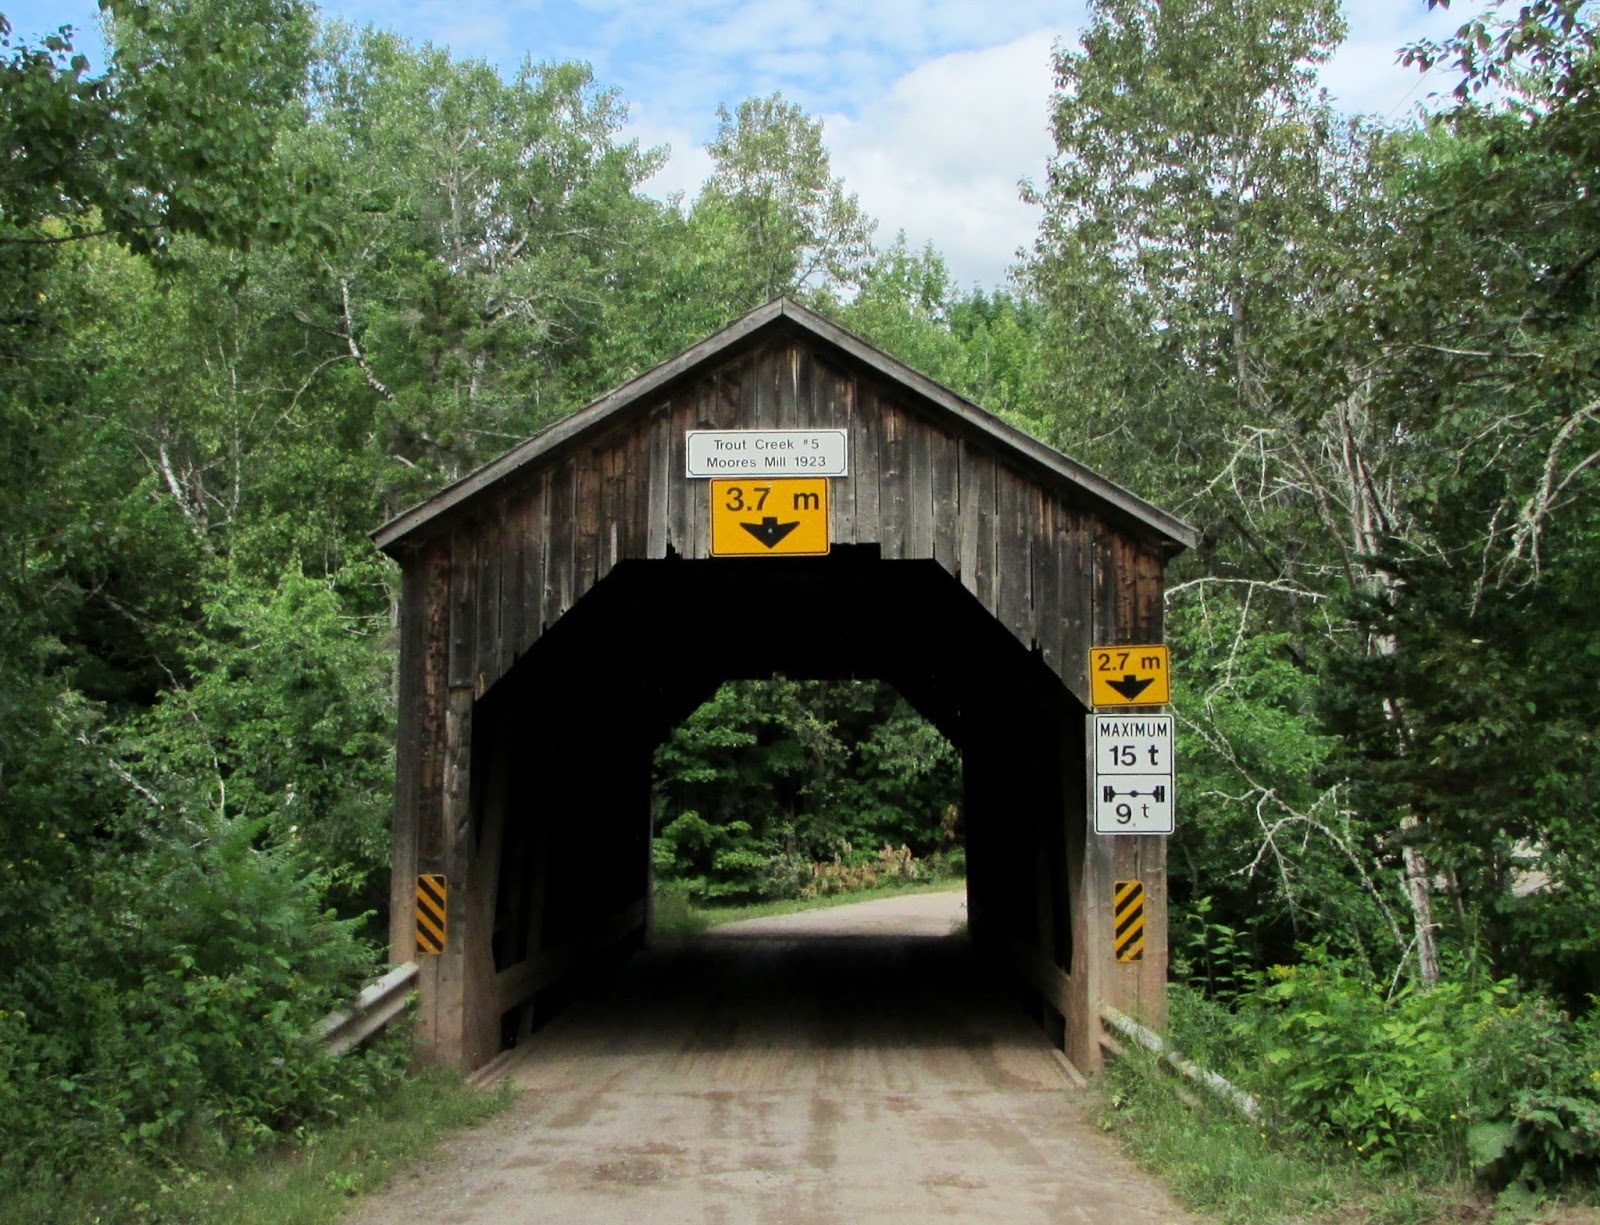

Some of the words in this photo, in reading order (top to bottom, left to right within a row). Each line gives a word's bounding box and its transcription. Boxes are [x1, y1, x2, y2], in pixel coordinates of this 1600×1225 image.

[714, 440, 746, 450] Trout
[755, 439, 794, 449] Creek
[707, 457, 756, 468] Moores
[765, 457, 786, 467] Mill
[794, 456, 826, 467] 1923
[726, 487, 771, 511] 3.7
[794, 492, 819, 510] m
[1098, 652, 1129, 671] 2.7
[1141, 656, 1160, 669] m
[1101, 723, 1167, 737] MAXIMUM
[1109, 746, 1136, 766] 15
[1148, 745, 1158, 766] t
[1116, 803, 1132, 824] 9
[1141, 804, 1150, 818] t
